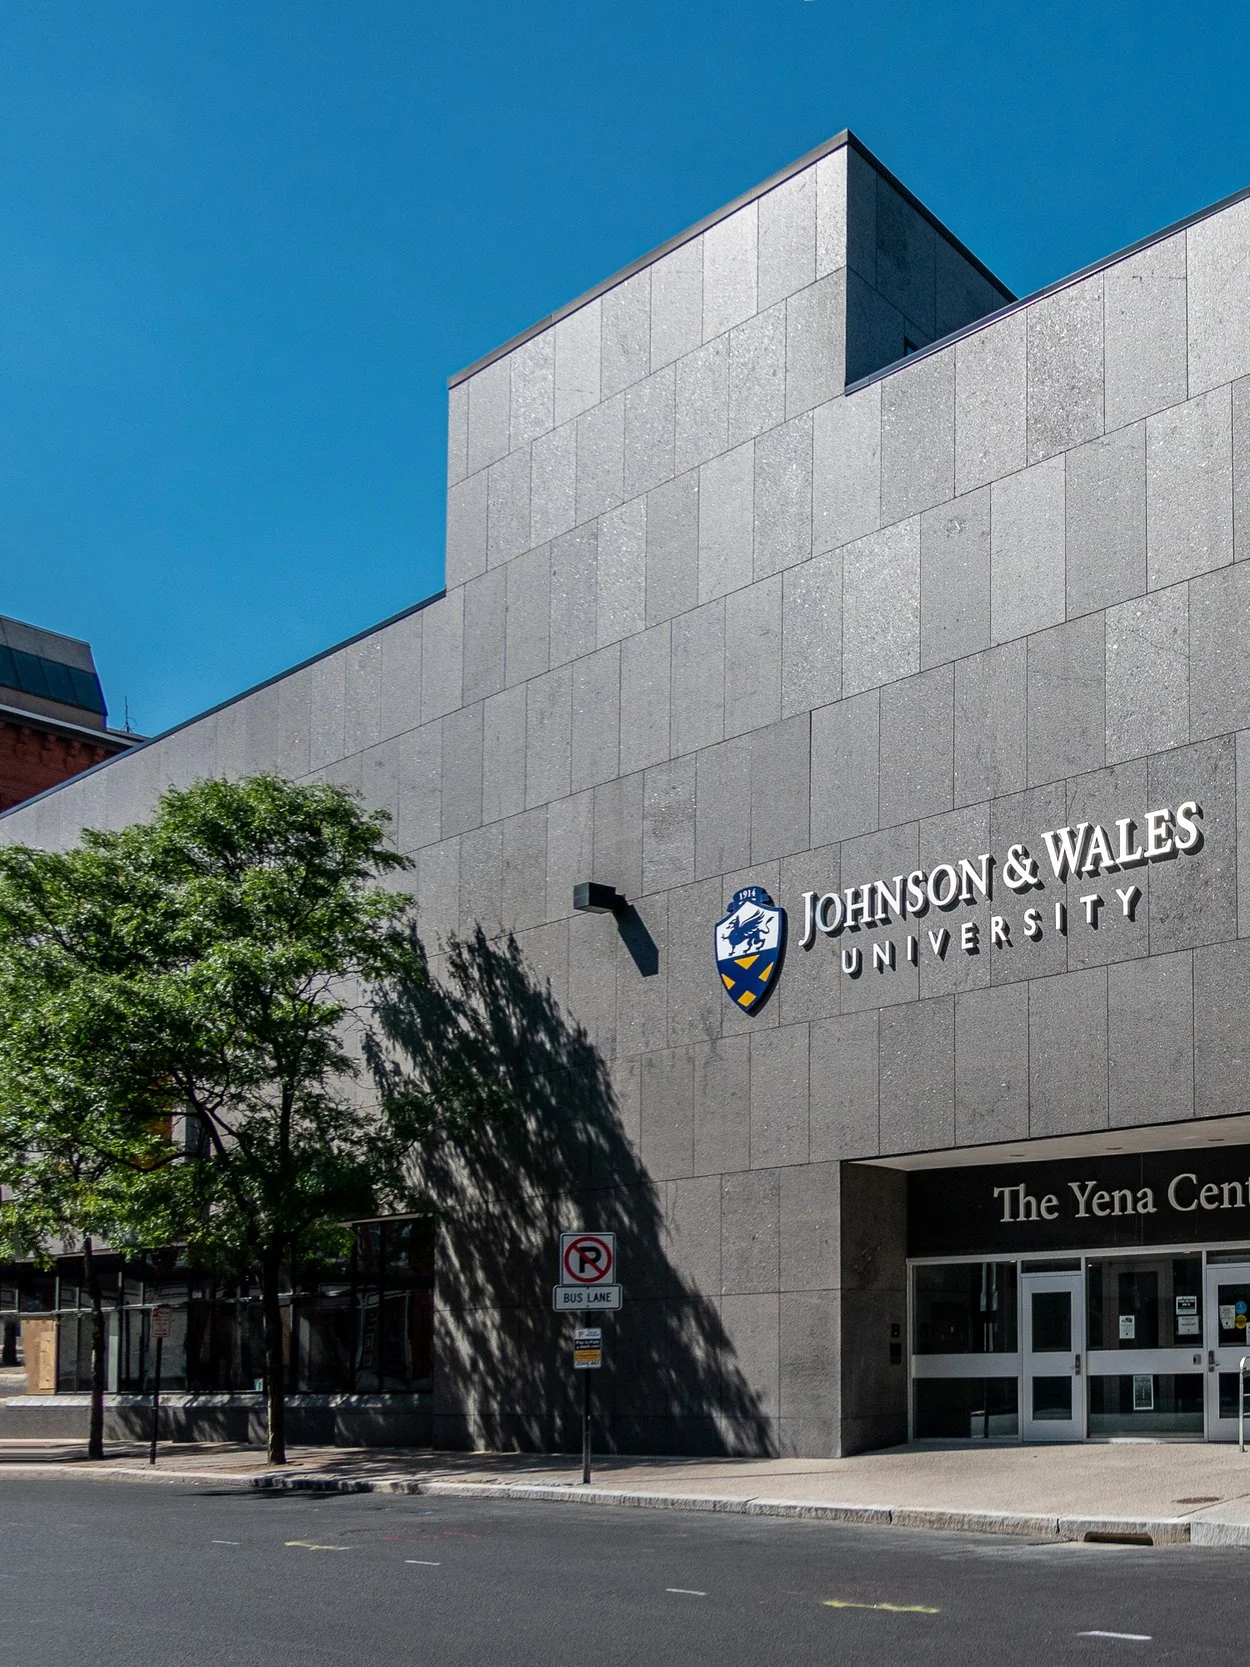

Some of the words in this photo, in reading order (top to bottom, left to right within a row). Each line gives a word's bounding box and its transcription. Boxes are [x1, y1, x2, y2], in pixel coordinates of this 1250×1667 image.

[799, 853, 993, 946] JOHNSON
[1002, 844, 1036, 889] &
[1041, 801, 1200, 874] WALES
[739, 888, 757, 900] 1914
[842, 886, 1138, 973] UNIVERSITY
[994, 1183, 1059, 1223] The
[1067, 1180, 1157, 1219] Yena
[578, 1246, 602, 1273] P
[563, 1293, 583, 1303] BUS
[587, 1292, 612, 1303] LANE
